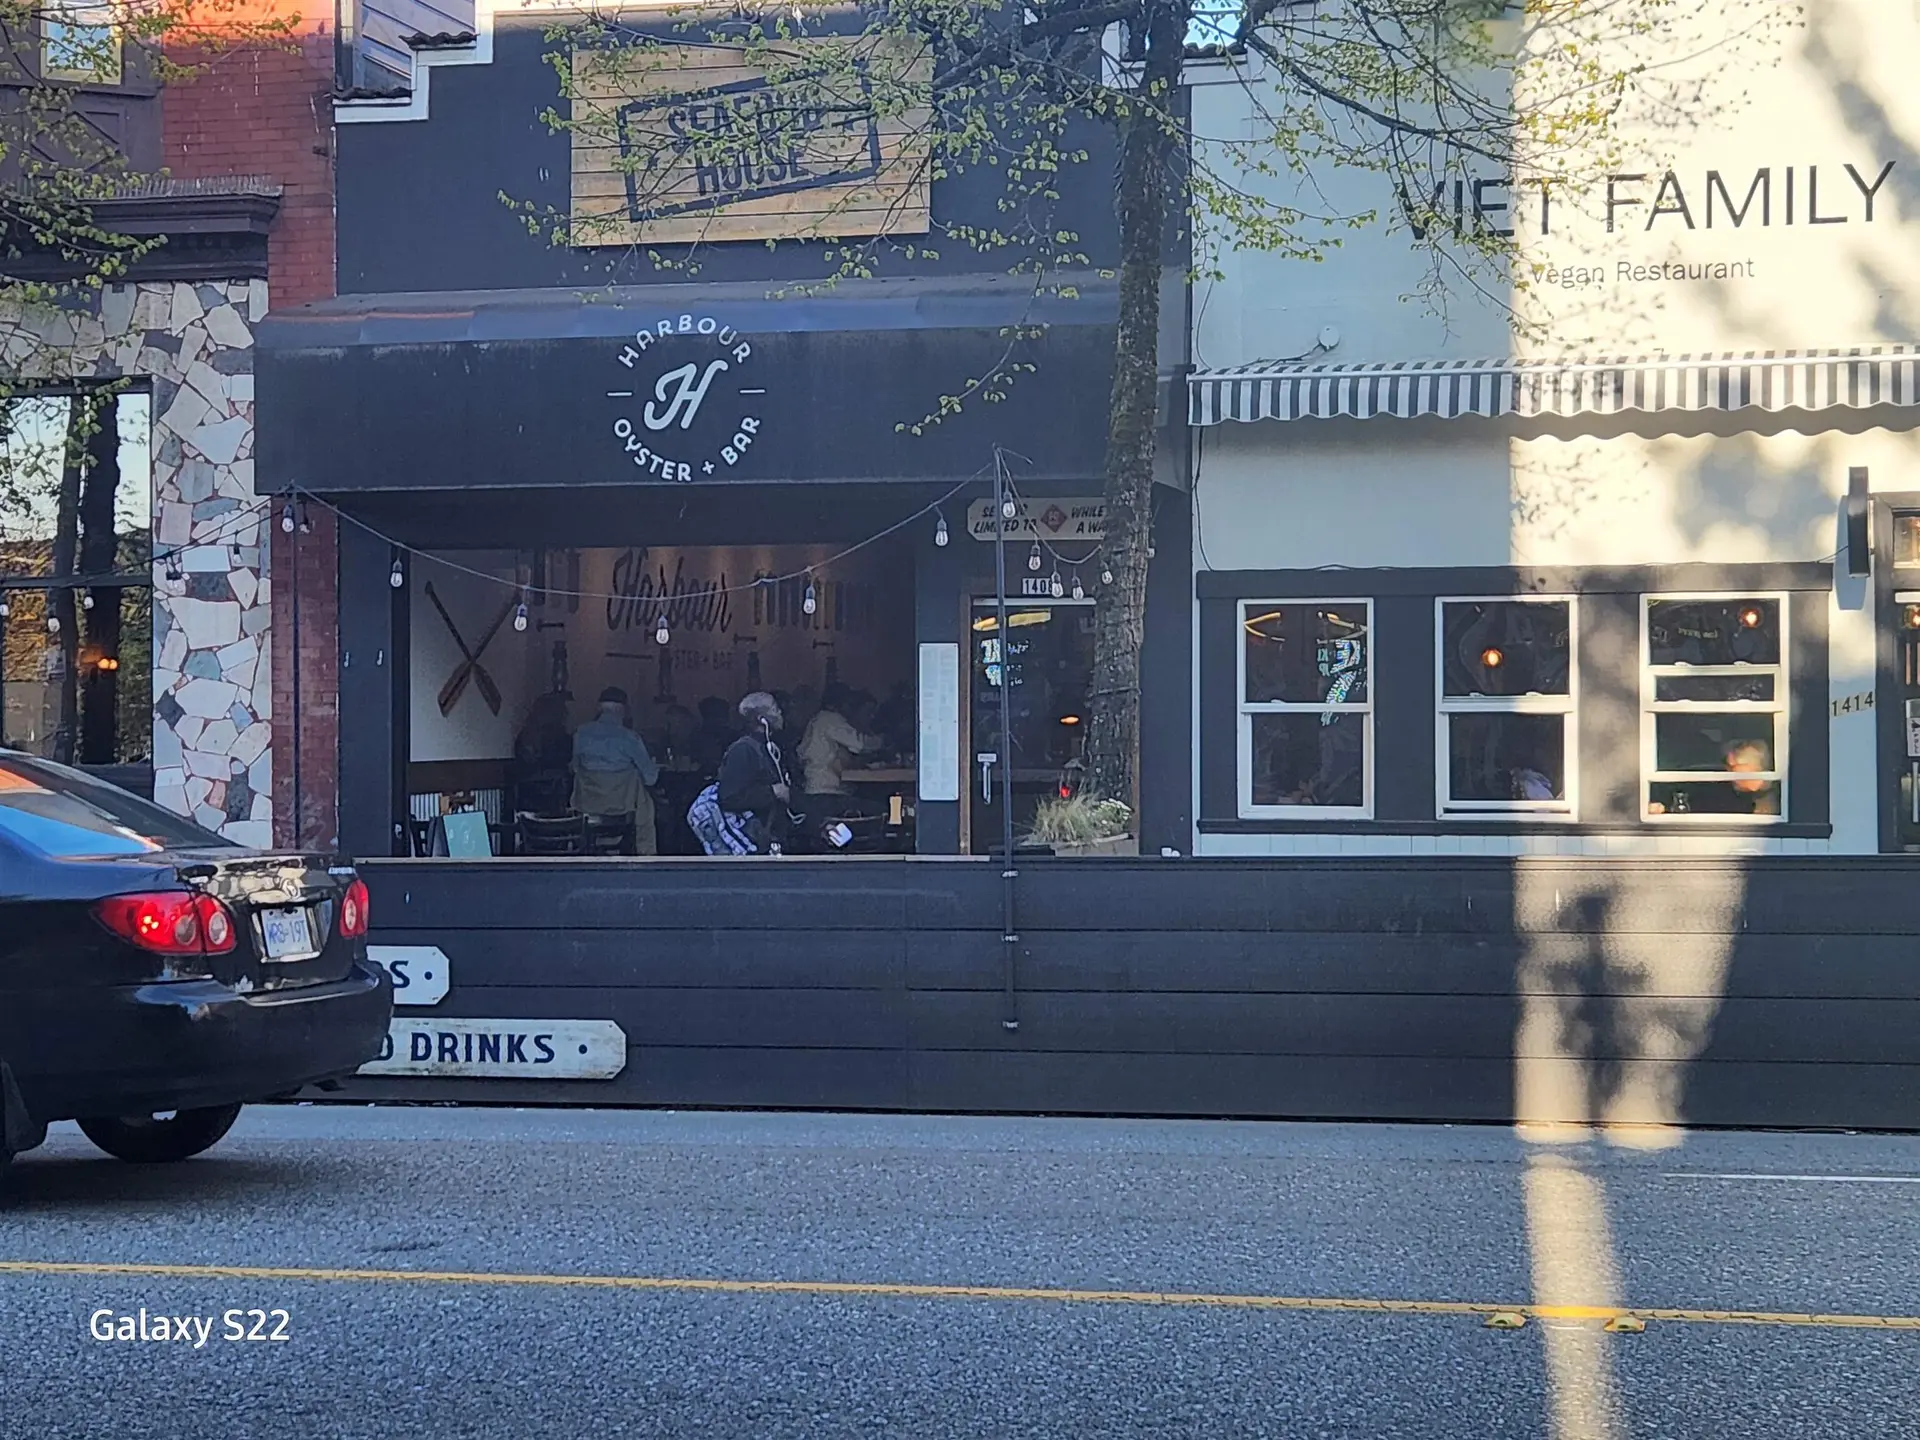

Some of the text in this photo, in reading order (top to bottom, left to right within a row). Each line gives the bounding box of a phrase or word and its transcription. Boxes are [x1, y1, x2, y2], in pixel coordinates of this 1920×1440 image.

[1395, 160, 1897, 240] VIET FAMILY
[1616, 258, 1755, 282] Restaurant
[617, 314, 751, 369] HARBOUR
[613, 418, 692, 482] OYSTER
[720, 416, 761, 466] BAR
[973, 518, 1020, 534] LIMTED
[1071, 505, 1105, 519] WHILE
[1831, 691, 1874, 717] 1414
[410, 1032, 556, 1064] DRINKS
